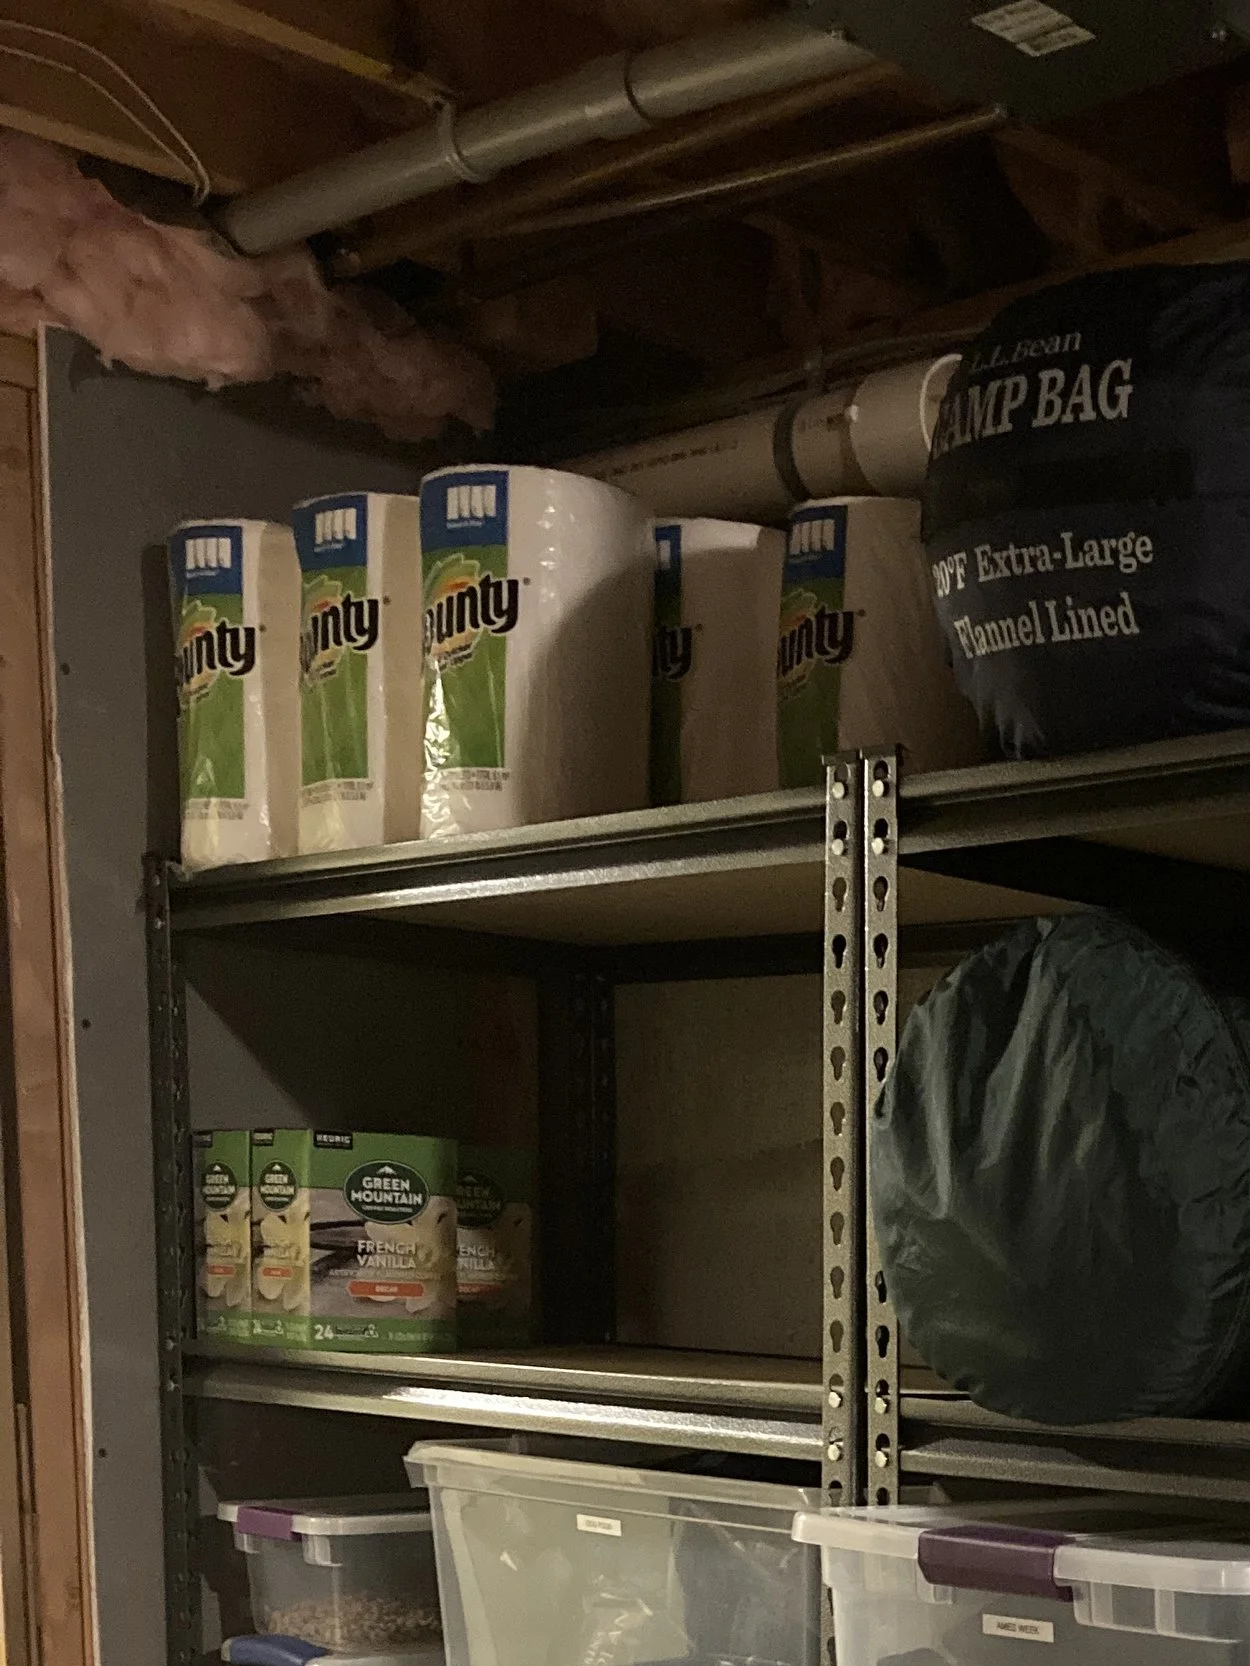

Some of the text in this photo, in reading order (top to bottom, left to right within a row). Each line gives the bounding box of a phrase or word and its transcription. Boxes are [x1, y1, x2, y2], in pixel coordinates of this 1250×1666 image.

[1031, 358, 1134, 429] BAG
[974, 531, 1154, 584] Extra-Large
[953, 590, 1140, 659] Flannel Lined
[315, 1134, 351, 1146] KEURIG
[264, 1174, 289, 1184] GREEN
[361, 1176, 411, 1192] GREEN
[260, 1185, 295, 1195] MOUNTAIN
[349, 1190, 424, 1206] MOUNTAIN
[356, 1239, 417, 1255] FRENCH
[458, 1243, 495, 1257] ENCH
[356, 1254, 418, 1270] VANILLA
[457, 1256, 496, 1271] NILLA
[314, 1324, 335, 1341] 24
[996, 1621, 1040, 1635] AMES WEEK
